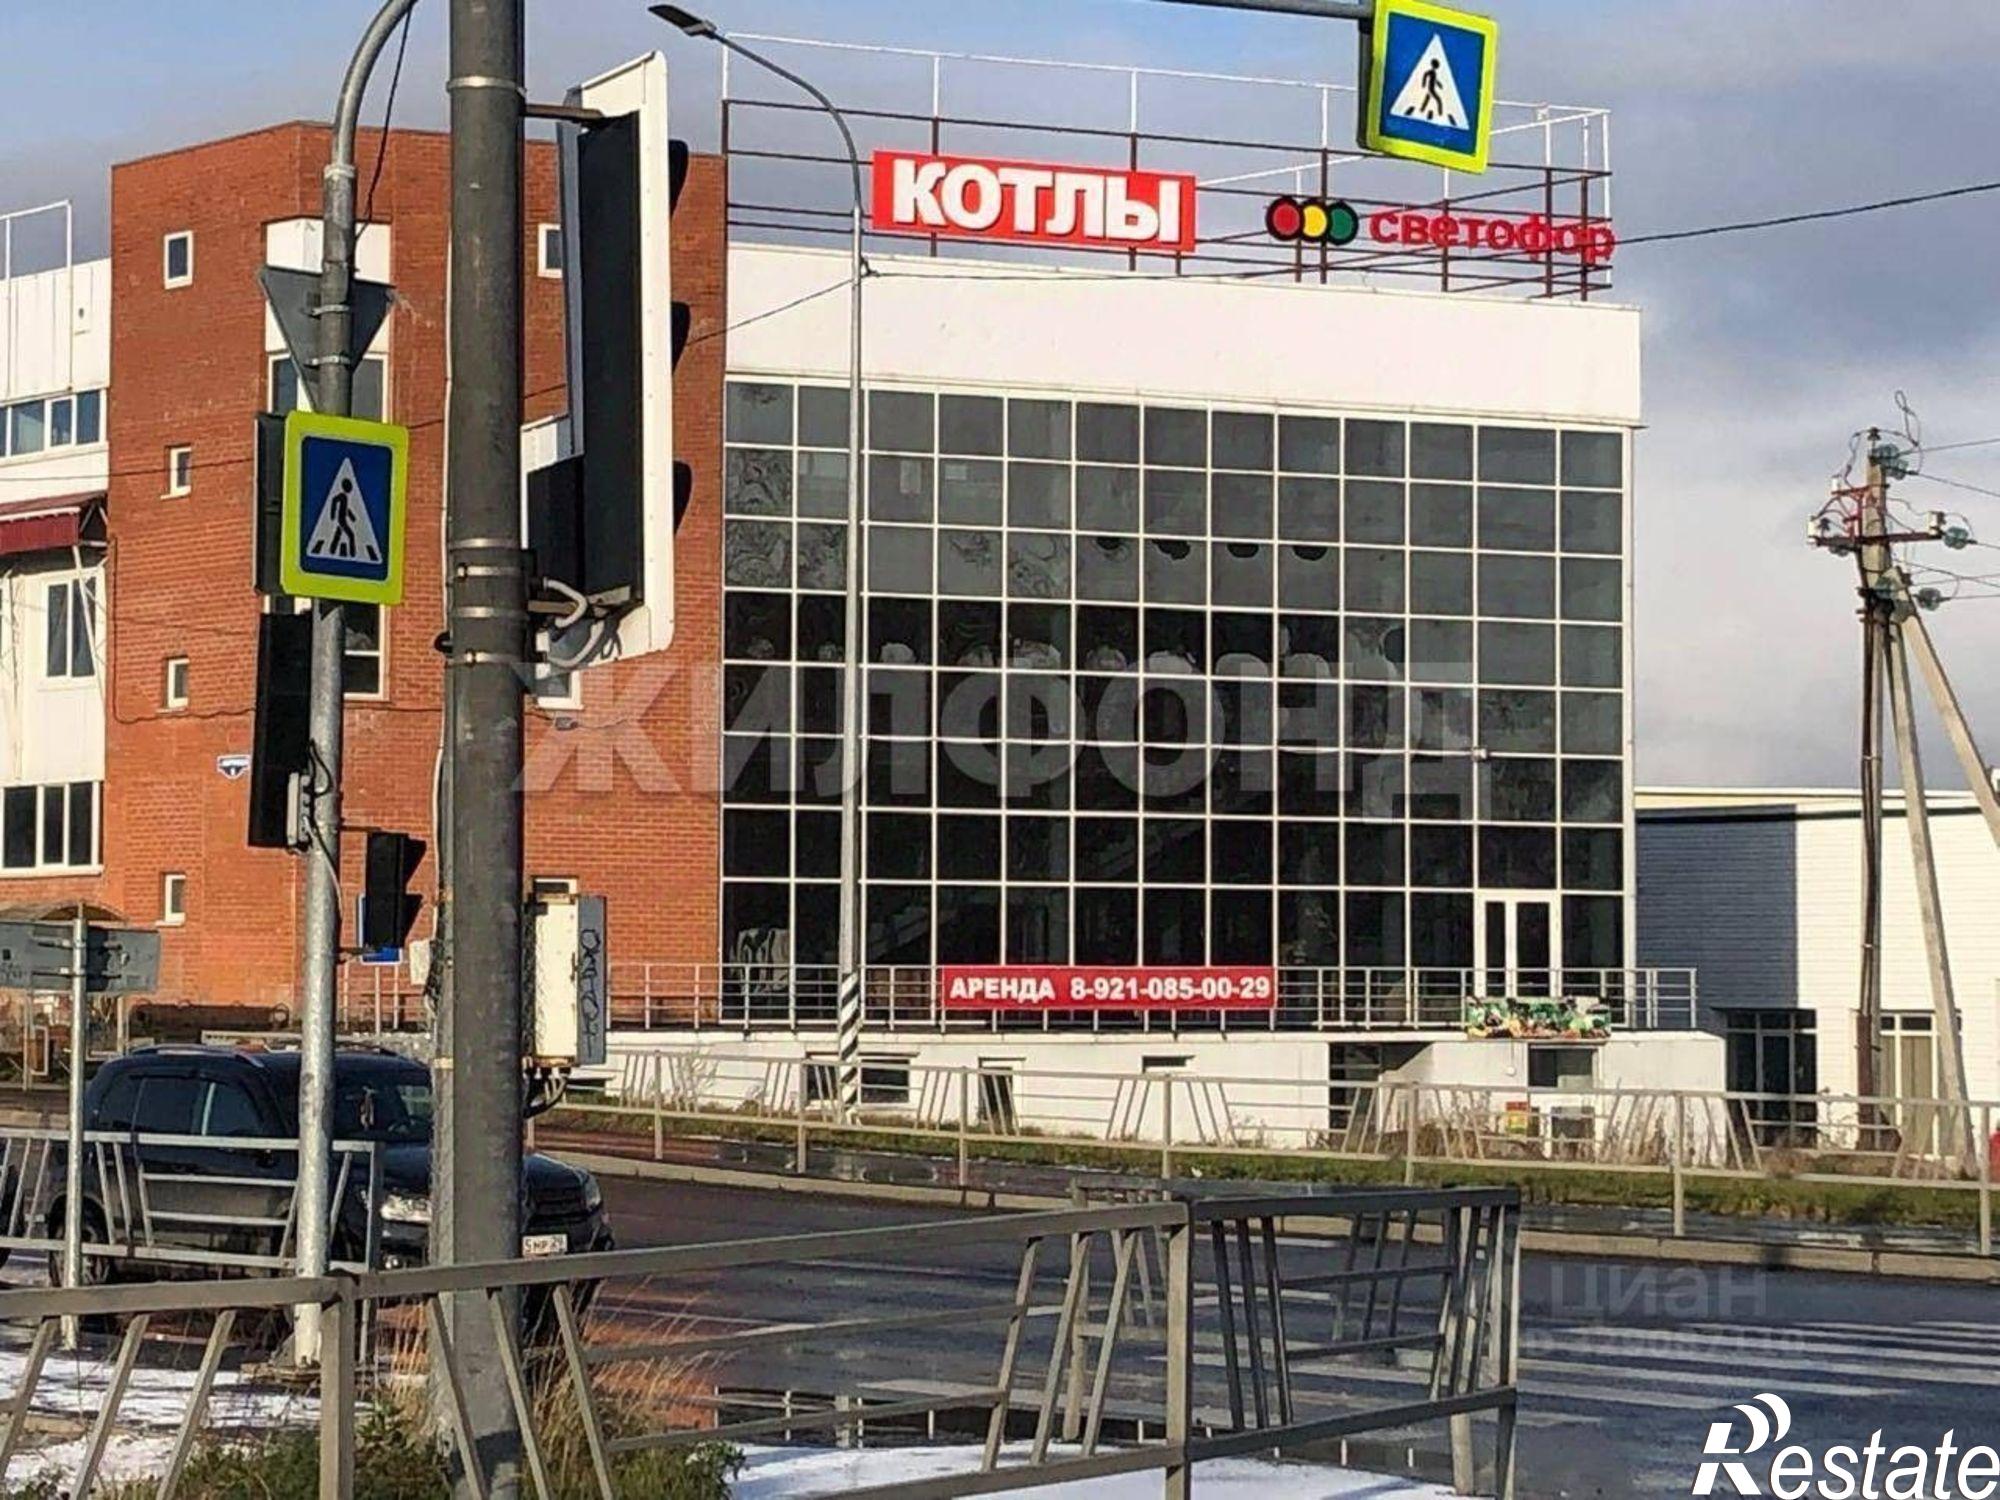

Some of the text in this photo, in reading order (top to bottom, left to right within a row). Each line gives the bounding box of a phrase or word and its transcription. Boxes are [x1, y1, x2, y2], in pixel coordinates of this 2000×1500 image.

[892, 158, 1181, 243] КОТЛЫ
[1369, 207, 1615, 267] светофор
[949, 976, 1272, 1004] АРЕНДА 8-921-085-00-29
